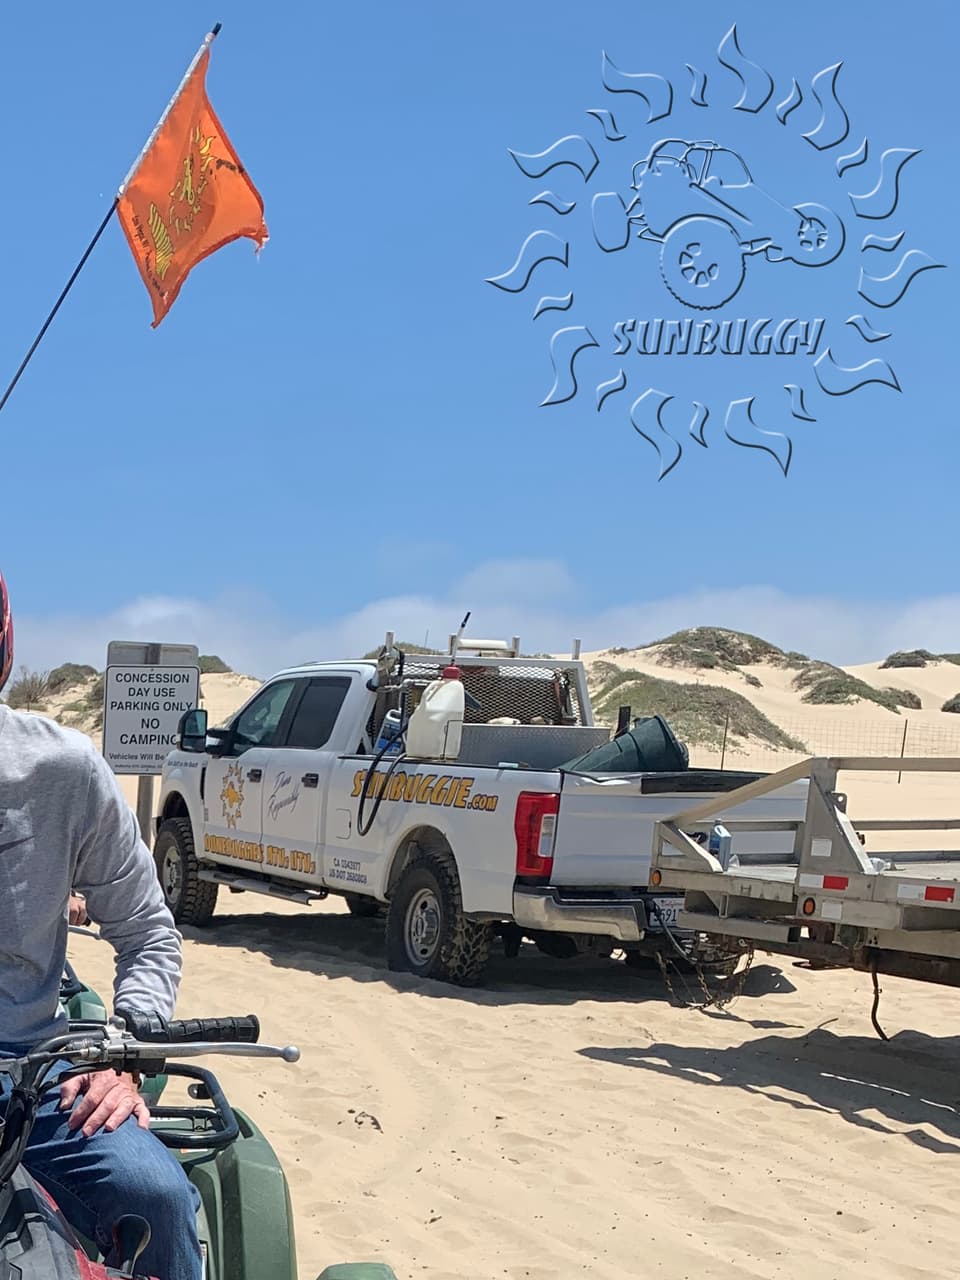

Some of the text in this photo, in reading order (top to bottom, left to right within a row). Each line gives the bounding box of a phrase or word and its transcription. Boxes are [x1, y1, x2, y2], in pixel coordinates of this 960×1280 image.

[115, 672, 190, 684] CONCESSION
[128, 687, 176, 697] DAY USE
[110, 701, 193, 712] PARKING ONLY
[141, 718, 160, 729] NO
[155, 753, 165, 761] Be
